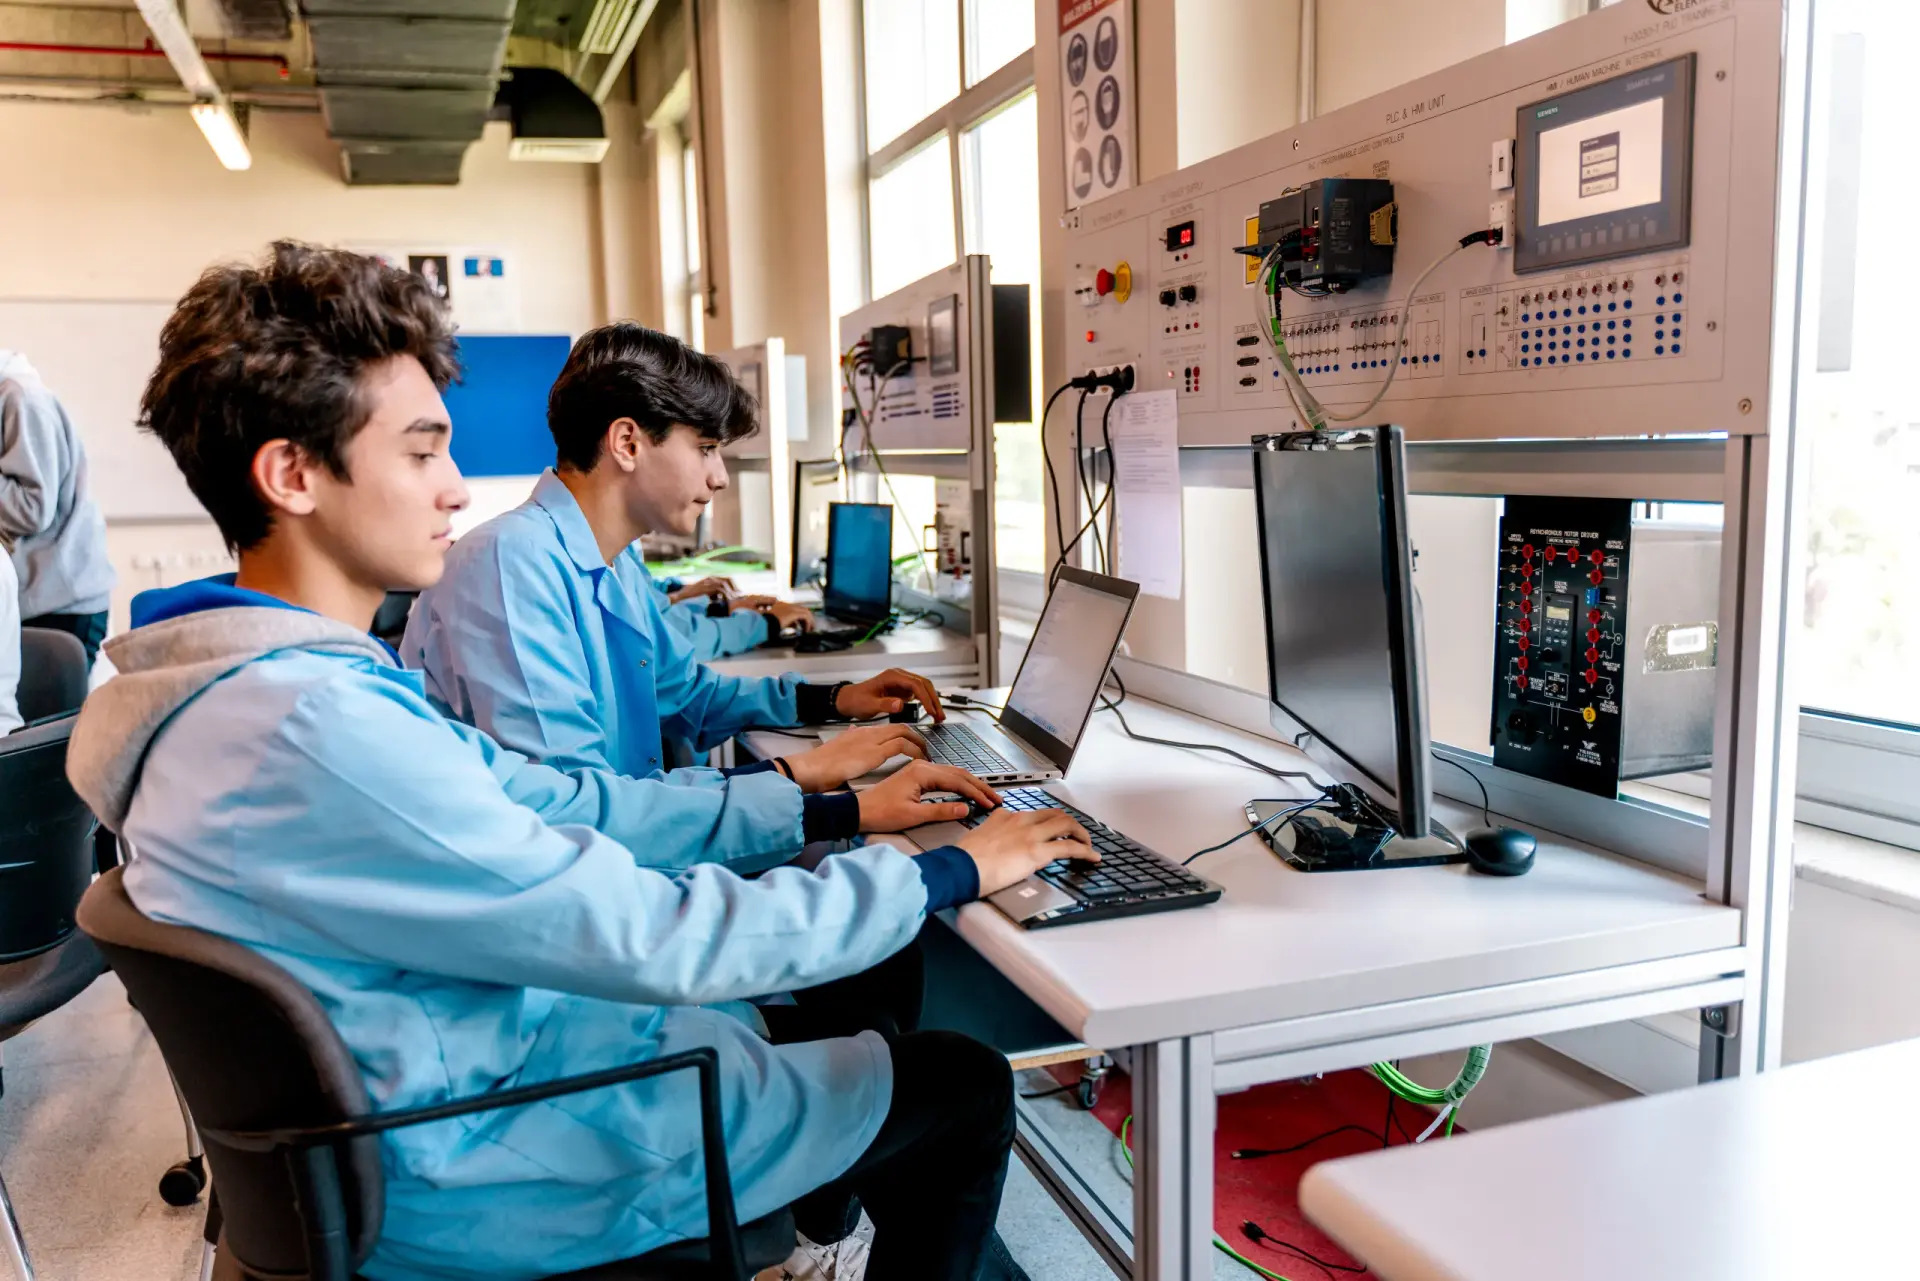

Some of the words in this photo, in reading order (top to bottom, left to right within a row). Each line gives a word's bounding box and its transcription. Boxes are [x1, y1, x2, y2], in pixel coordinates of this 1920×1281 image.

[1546, 82, 1558, 93] HMI
[1566, 70, 1590, 86] HUMAN
[1592, 60, 1620, 78] MACHINE
[1625, 48, 1663, 67] INTERFACE
[1386, 111, 1400, 124] PLC
[1402, 108, 1408, 120] &
[1411, 103, 1425, 116] HMI
[1428, 94, 1446, 111] UNIT
[1537, 106, 1558, 118] SIEMENS
[1372, 132, 1405, 150] CONTROLLER
[1530, 528, 1562, 537] ASYNCHRONOUS
